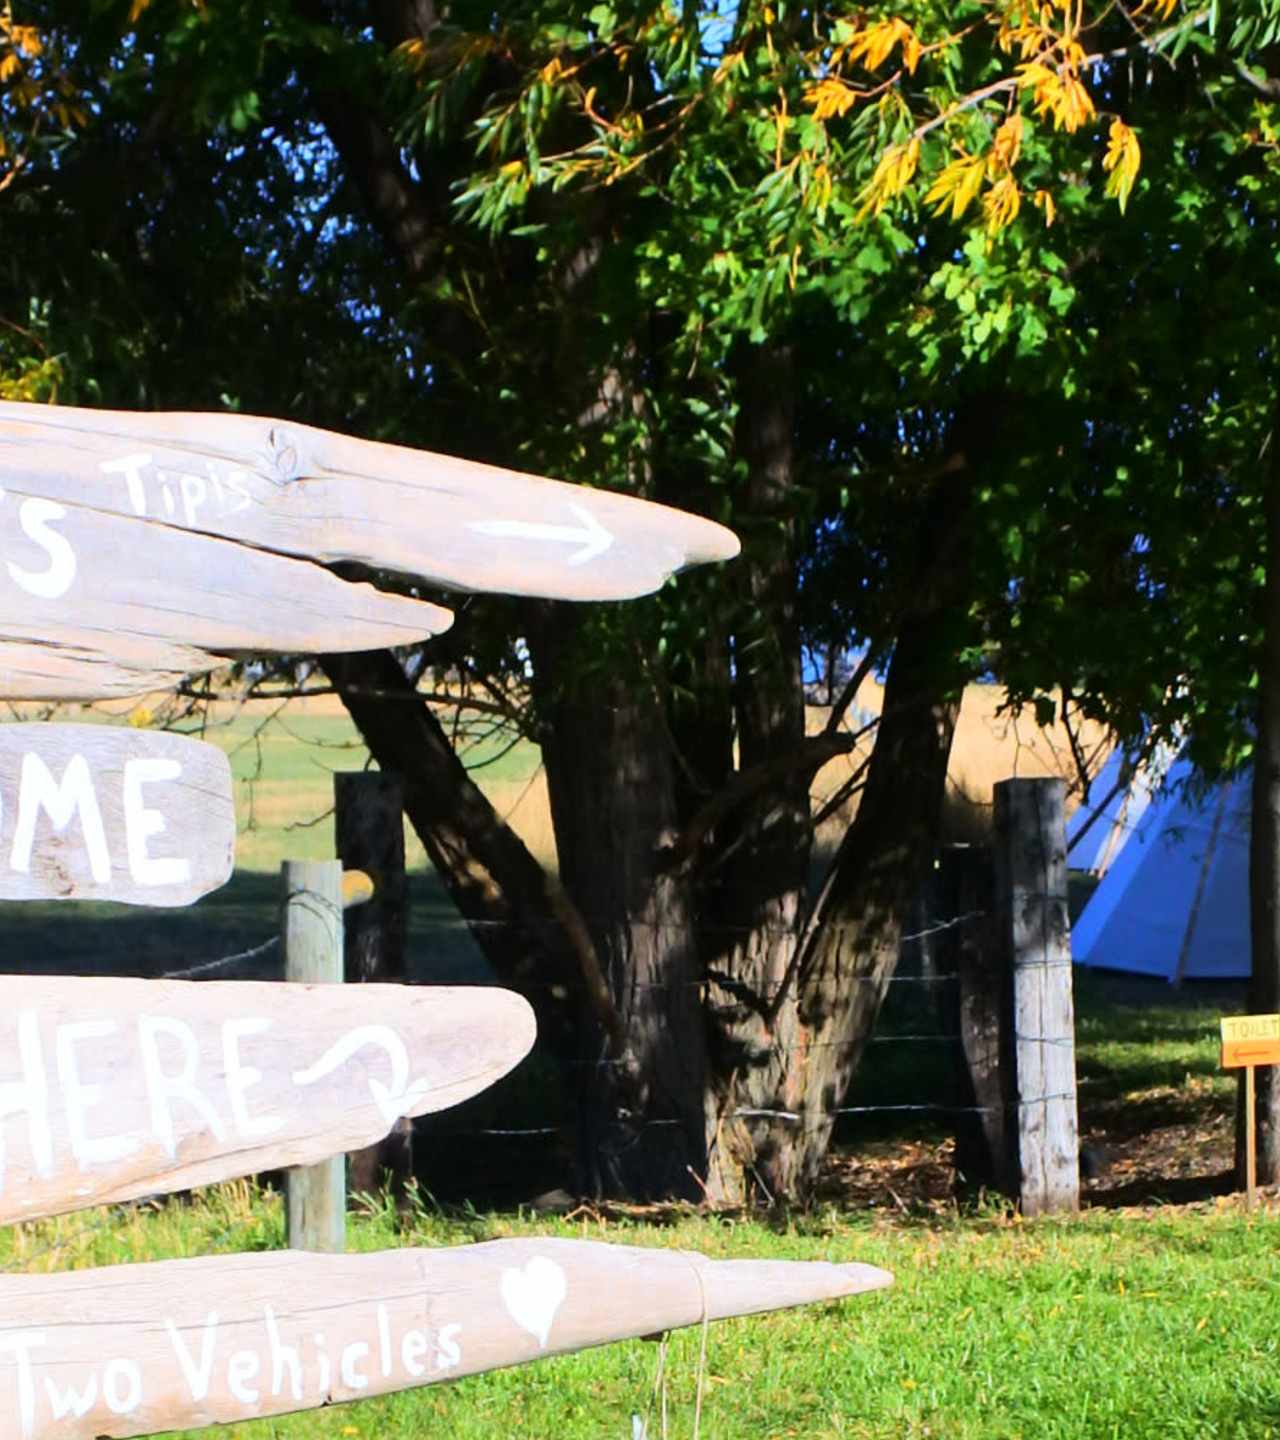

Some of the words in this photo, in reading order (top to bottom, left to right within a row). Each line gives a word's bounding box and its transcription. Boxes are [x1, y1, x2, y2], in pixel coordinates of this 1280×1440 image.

[99, 453, 253, 529] Tipis
[1227, 1019, 1279, 1037] TOILET
[163, 1302, 463, 1408] Vehicles
